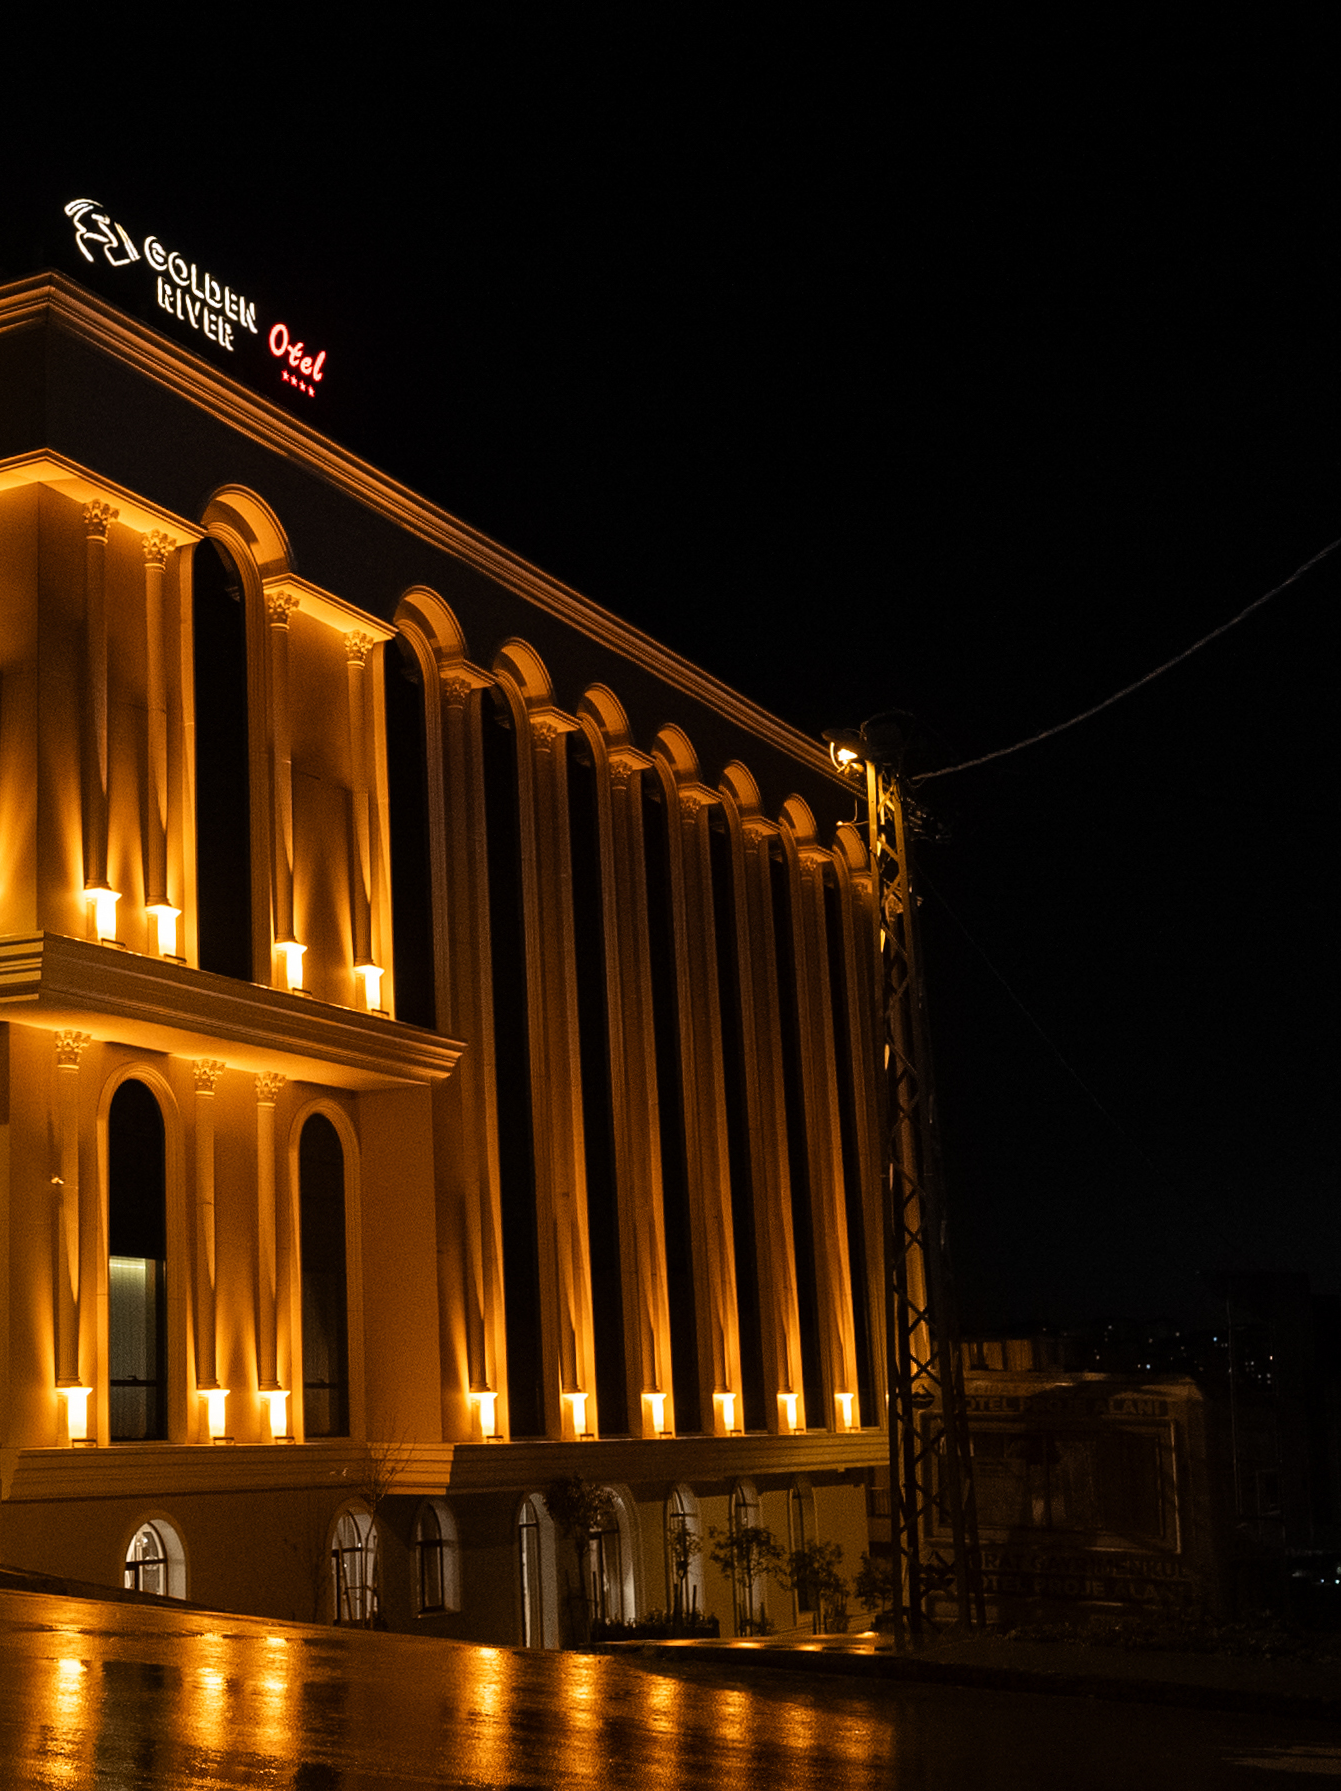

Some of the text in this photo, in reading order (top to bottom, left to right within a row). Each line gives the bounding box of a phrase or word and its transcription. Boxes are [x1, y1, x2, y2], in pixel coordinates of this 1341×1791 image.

[143, 235, 258, 334] GOLDEN
[157, 275, 234, 351] RIVER
[268, 322, 327, 382] Otel
